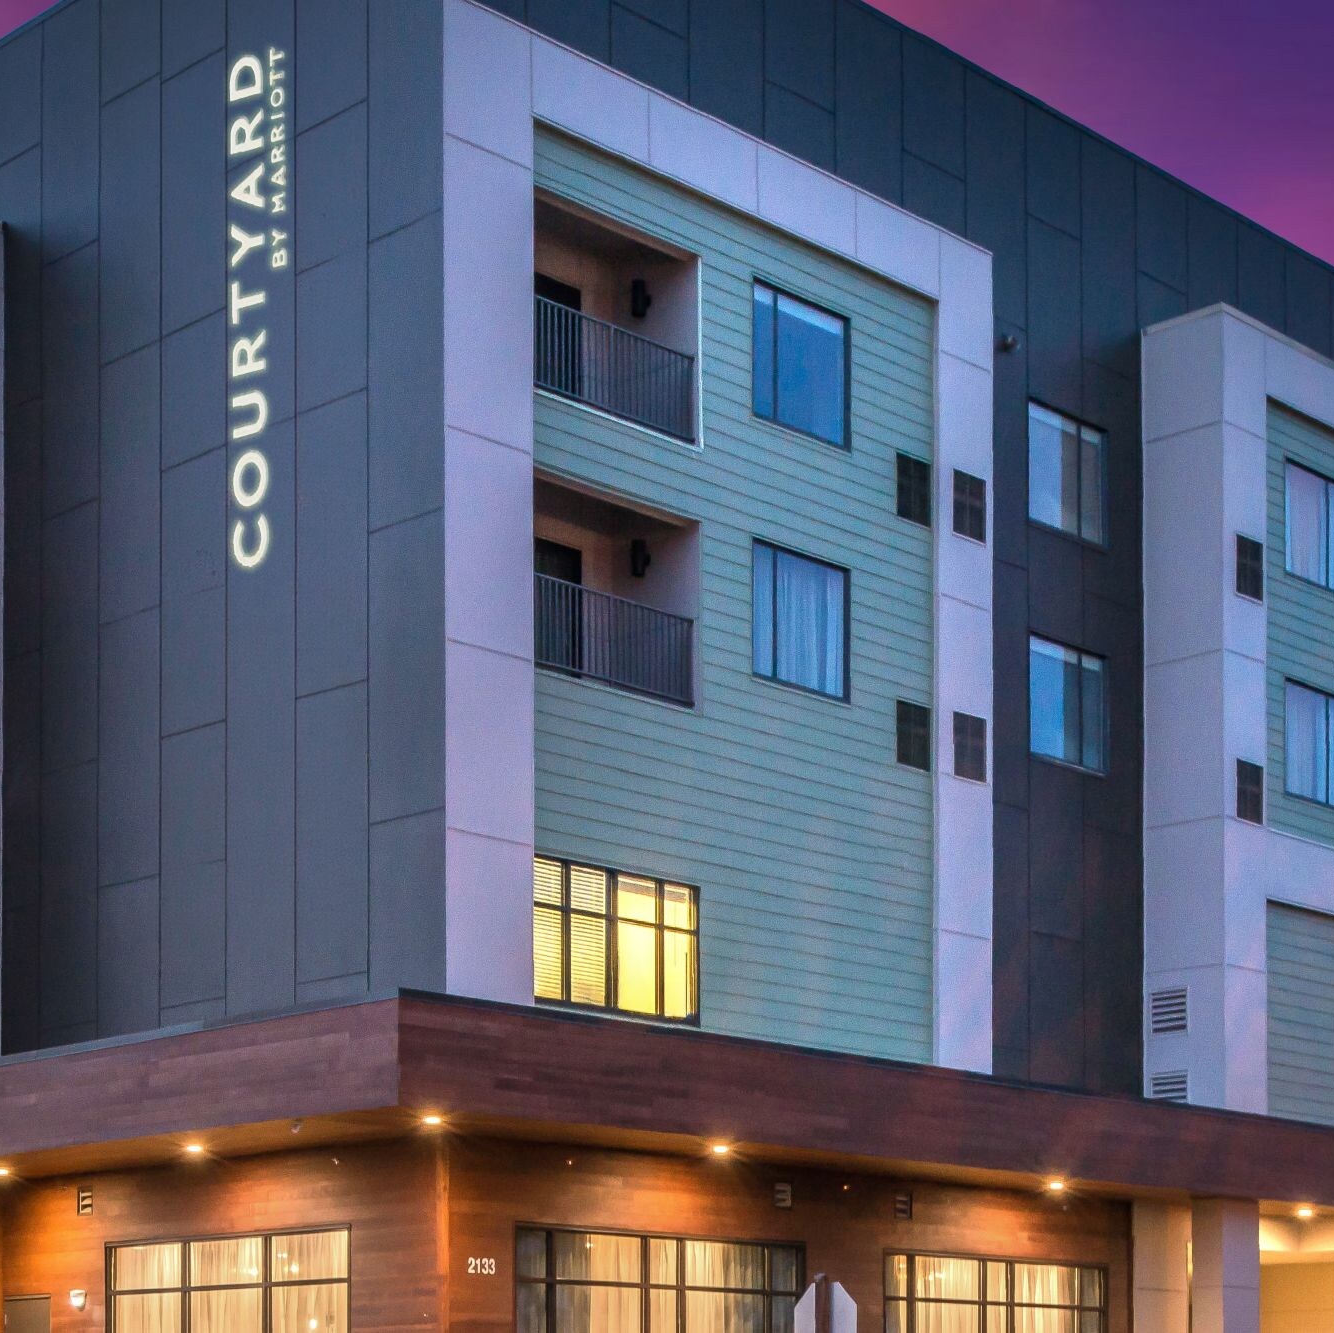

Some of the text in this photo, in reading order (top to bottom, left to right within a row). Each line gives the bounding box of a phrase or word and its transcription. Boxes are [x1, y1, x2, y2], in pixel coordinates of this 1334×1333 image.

[269, 46, 287, 268] BY MARRIOTT
[229, 54, 269, 567] COURTYARD
[467, 1256, 495, 1275] 2133
